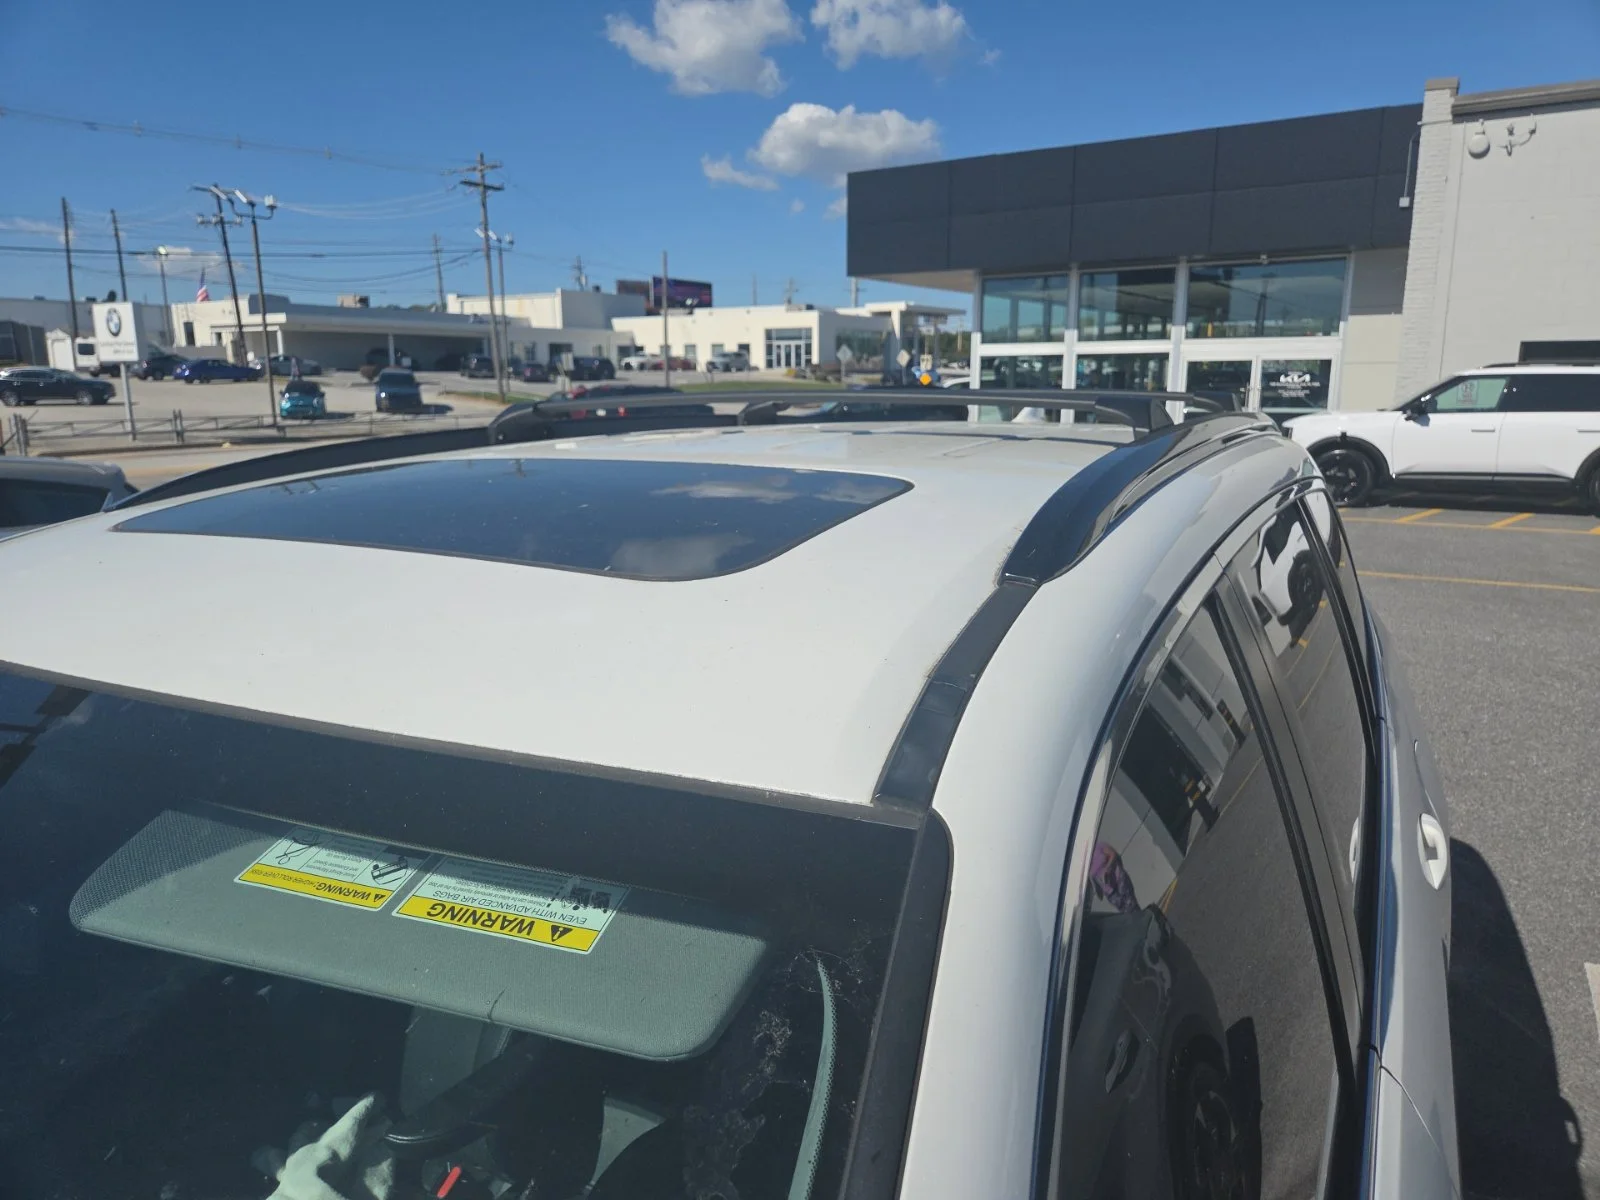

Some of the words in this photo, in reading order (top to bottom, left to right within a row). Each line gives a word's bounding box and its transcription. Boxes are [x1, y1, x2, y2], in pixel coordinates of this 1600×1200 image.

[433, 890, 460, 900] BAGS
[461, 895, 479, 904] AIR
[478, 898, 531, 913] ADVANCED
[531, 907, 557, 919] WITH
[558, 913, 587, 925] EVEN
[426, 903, 535, 936] WARNING
